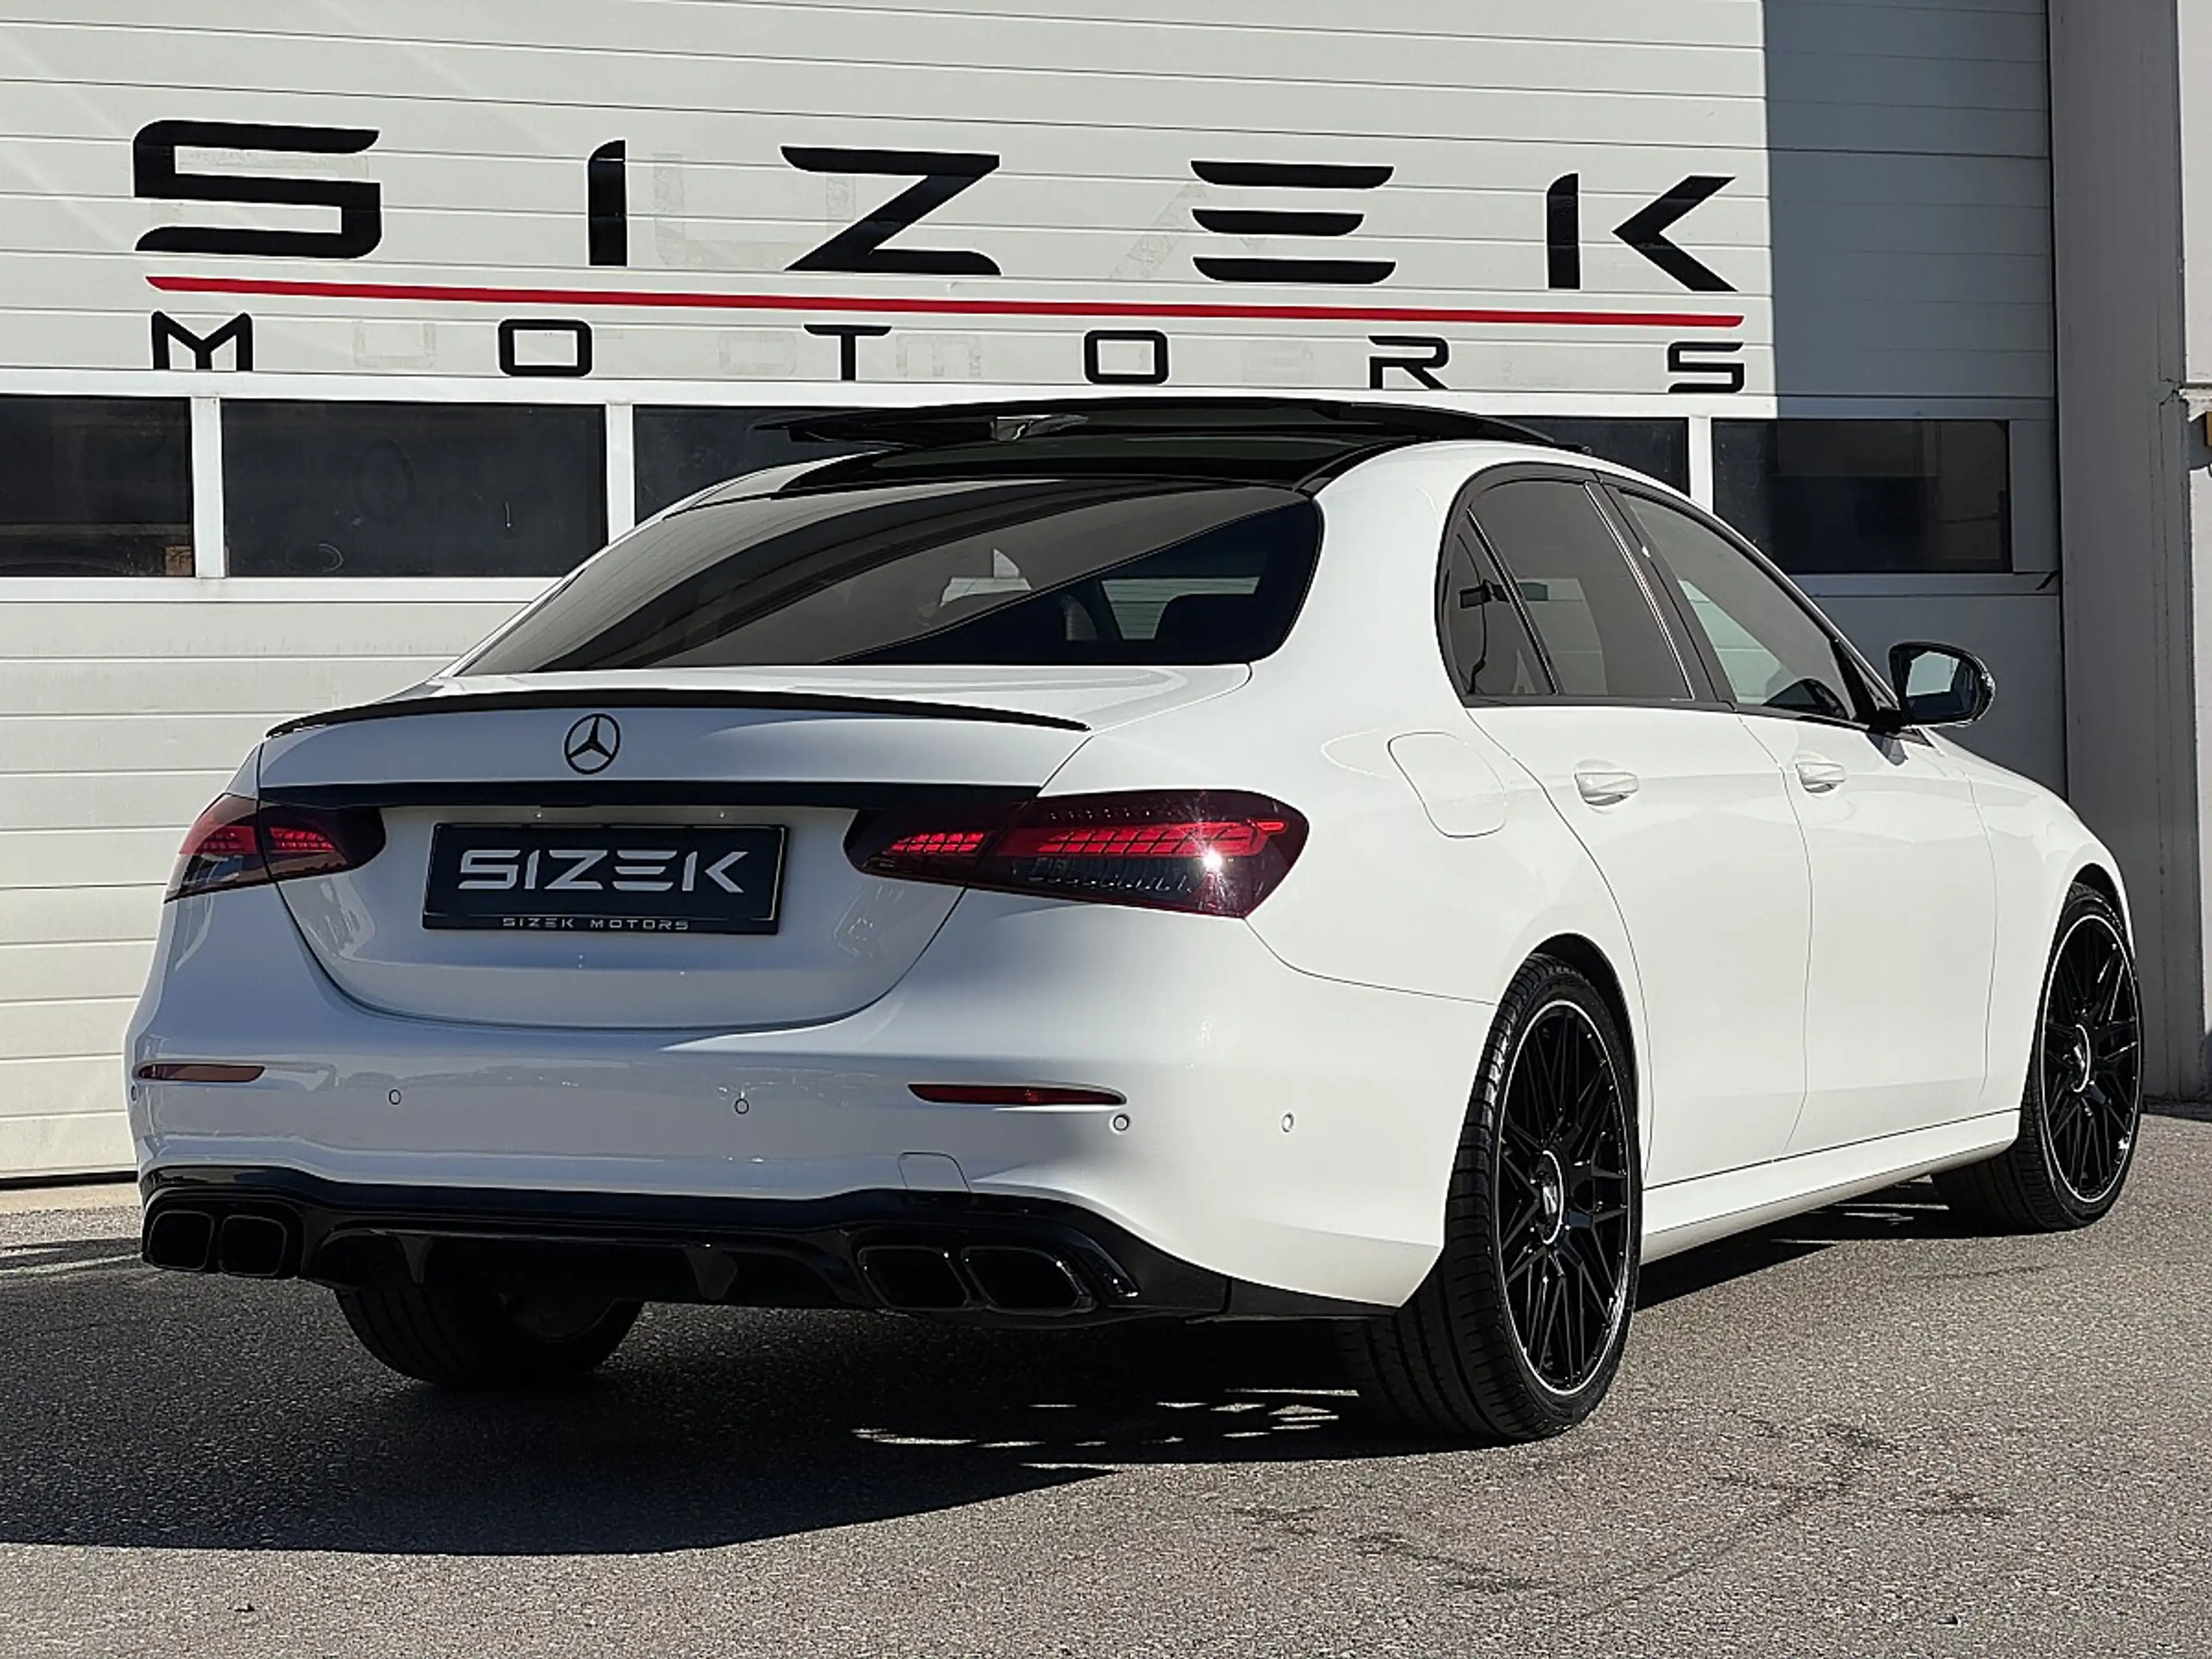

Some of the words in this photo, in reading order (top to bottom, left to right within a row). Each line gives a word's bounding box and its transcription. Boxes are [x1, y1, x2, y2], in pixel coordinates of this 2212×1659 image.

[133, 119, 1738, 292] SIZEK
[151, 310, 1745, 393] MOTORS
[458, 850, 748, 893] SIZEK
[502, 918, 574, 929] SIZEK
[589, 919, 689, 930] MOTORS
